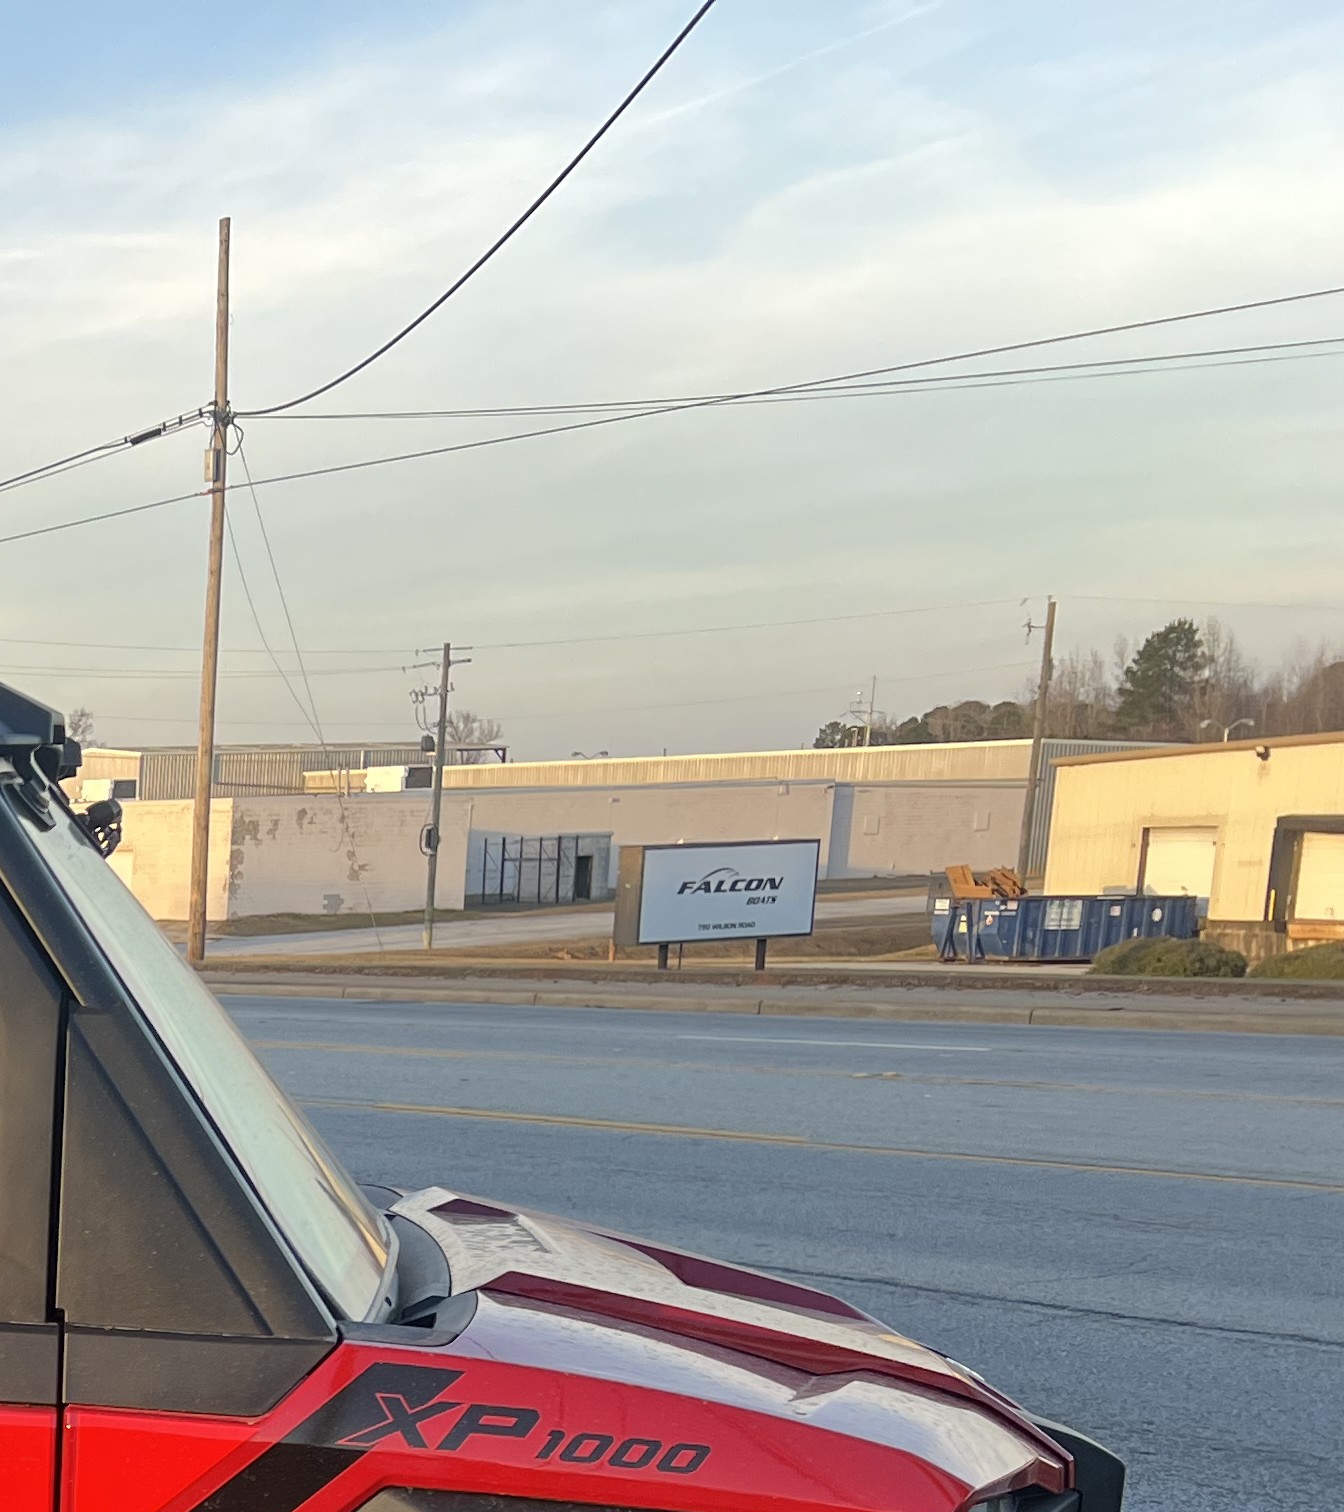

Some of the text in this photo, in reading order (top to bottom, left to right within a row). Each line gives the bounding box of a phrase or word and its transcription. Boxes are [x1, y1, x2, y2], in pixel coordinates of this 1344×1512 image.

[677, 876, 784, 895] FALCON
[746, 895, 778, 905] BOATS
[336, 1393, 711, 1475] XP 1000
